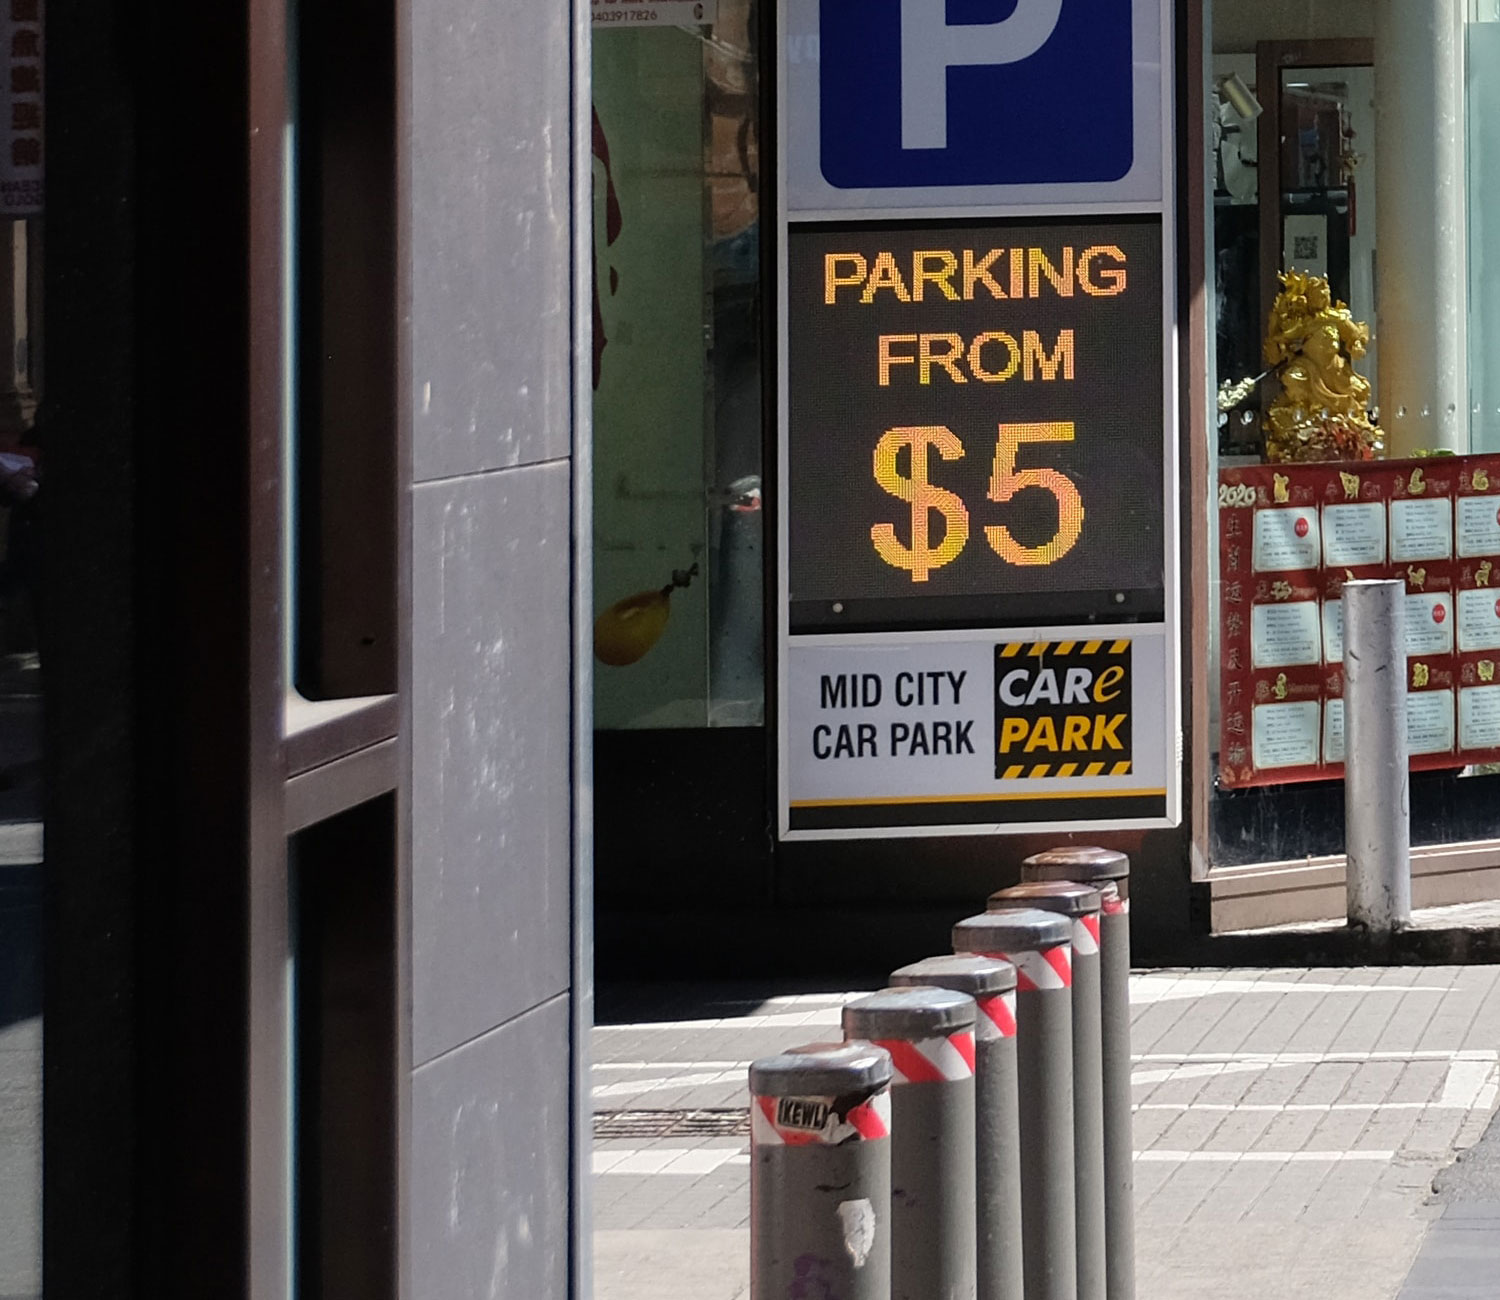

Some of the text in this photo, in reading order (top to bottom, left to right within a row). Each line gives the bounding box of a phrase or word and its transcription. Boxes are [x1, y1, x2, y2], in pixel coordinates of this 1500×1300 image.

[823, 243, 1129, 307] PARKING
[877, 328, 1077, 387] FROM
[870, 421, 1086, 583] $5
[1218, 482, 1257, 508] 2020
[819, 670, 968, 711] MID CITY
[812, 719, 976, 760] CAR PARK
[999, 713, 1129, 754] PARK
